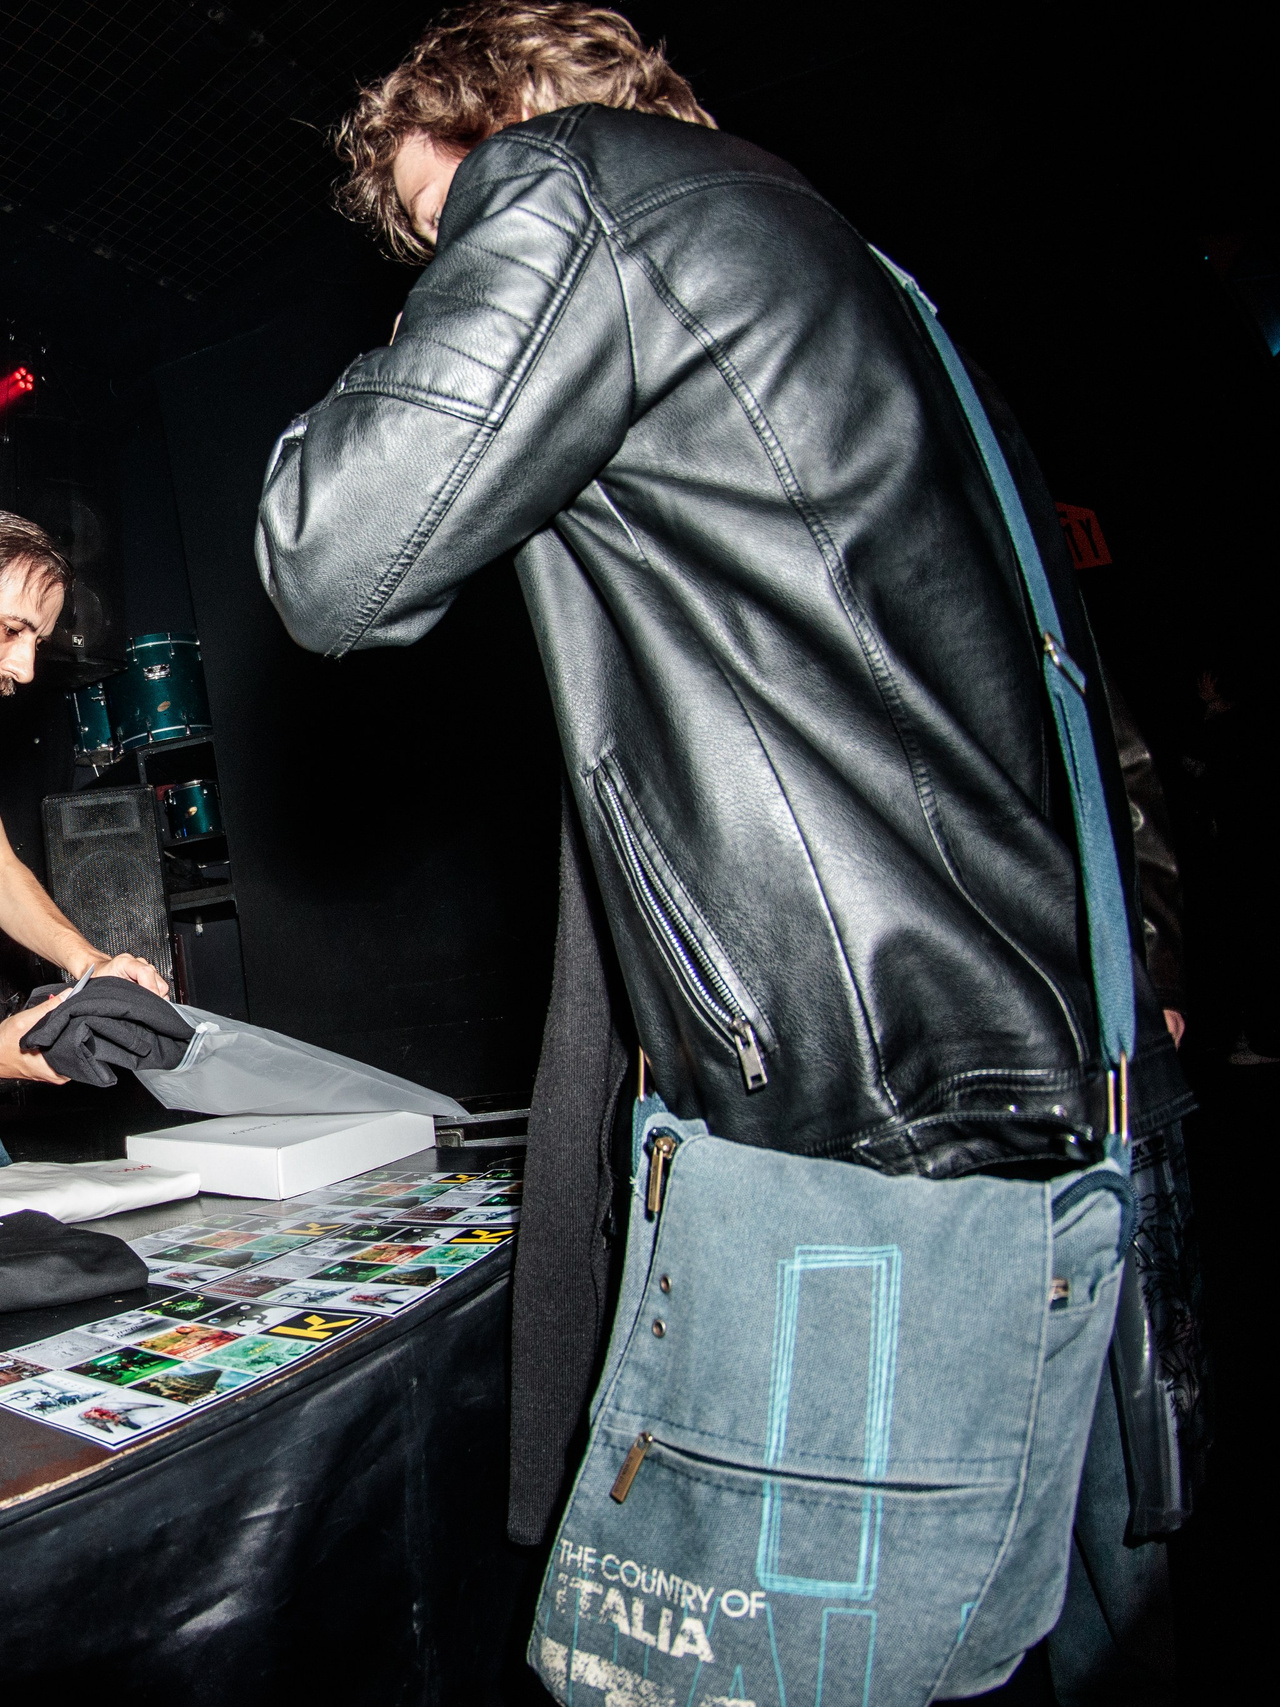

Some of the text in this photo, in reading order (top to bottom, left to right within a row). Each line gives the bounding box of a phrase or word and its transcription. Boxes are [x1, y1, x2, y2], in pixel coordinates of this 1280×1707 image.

[560, 1538, 767, 1619] THE COUNTRY OF
